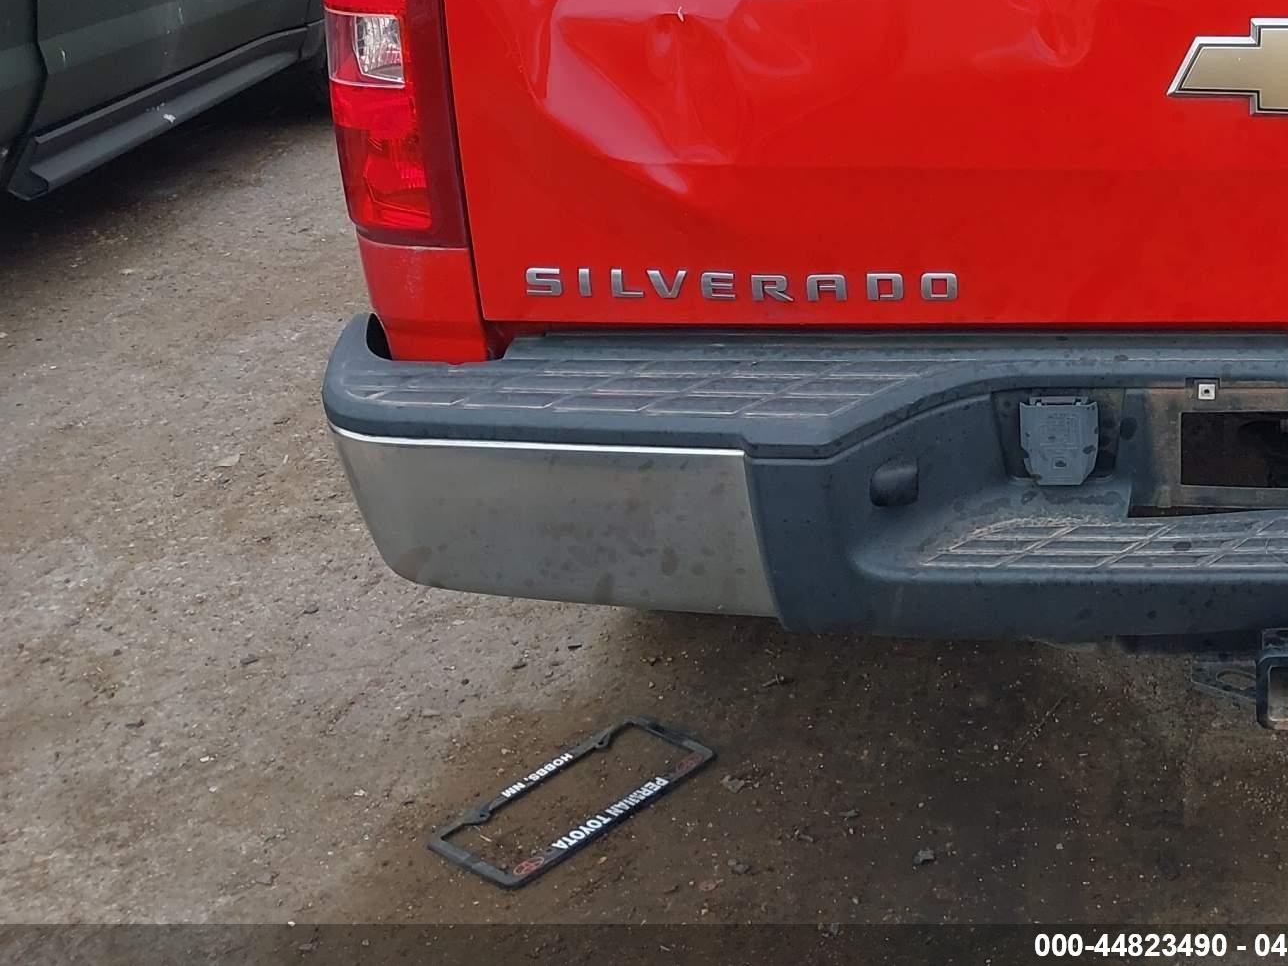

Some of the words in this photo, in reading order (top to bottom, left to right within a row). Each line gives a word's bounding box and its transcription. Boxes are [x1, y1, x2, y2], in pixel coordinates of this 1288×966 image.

[524, 266, 960, 303] SILVERADO
[524, 752, 574, 782] HOBBS,
[501, 781, 526, 799] NM
[604, 776, 670, 818] PERMIAN
[551, 814, 613, 850] TOYOTA
